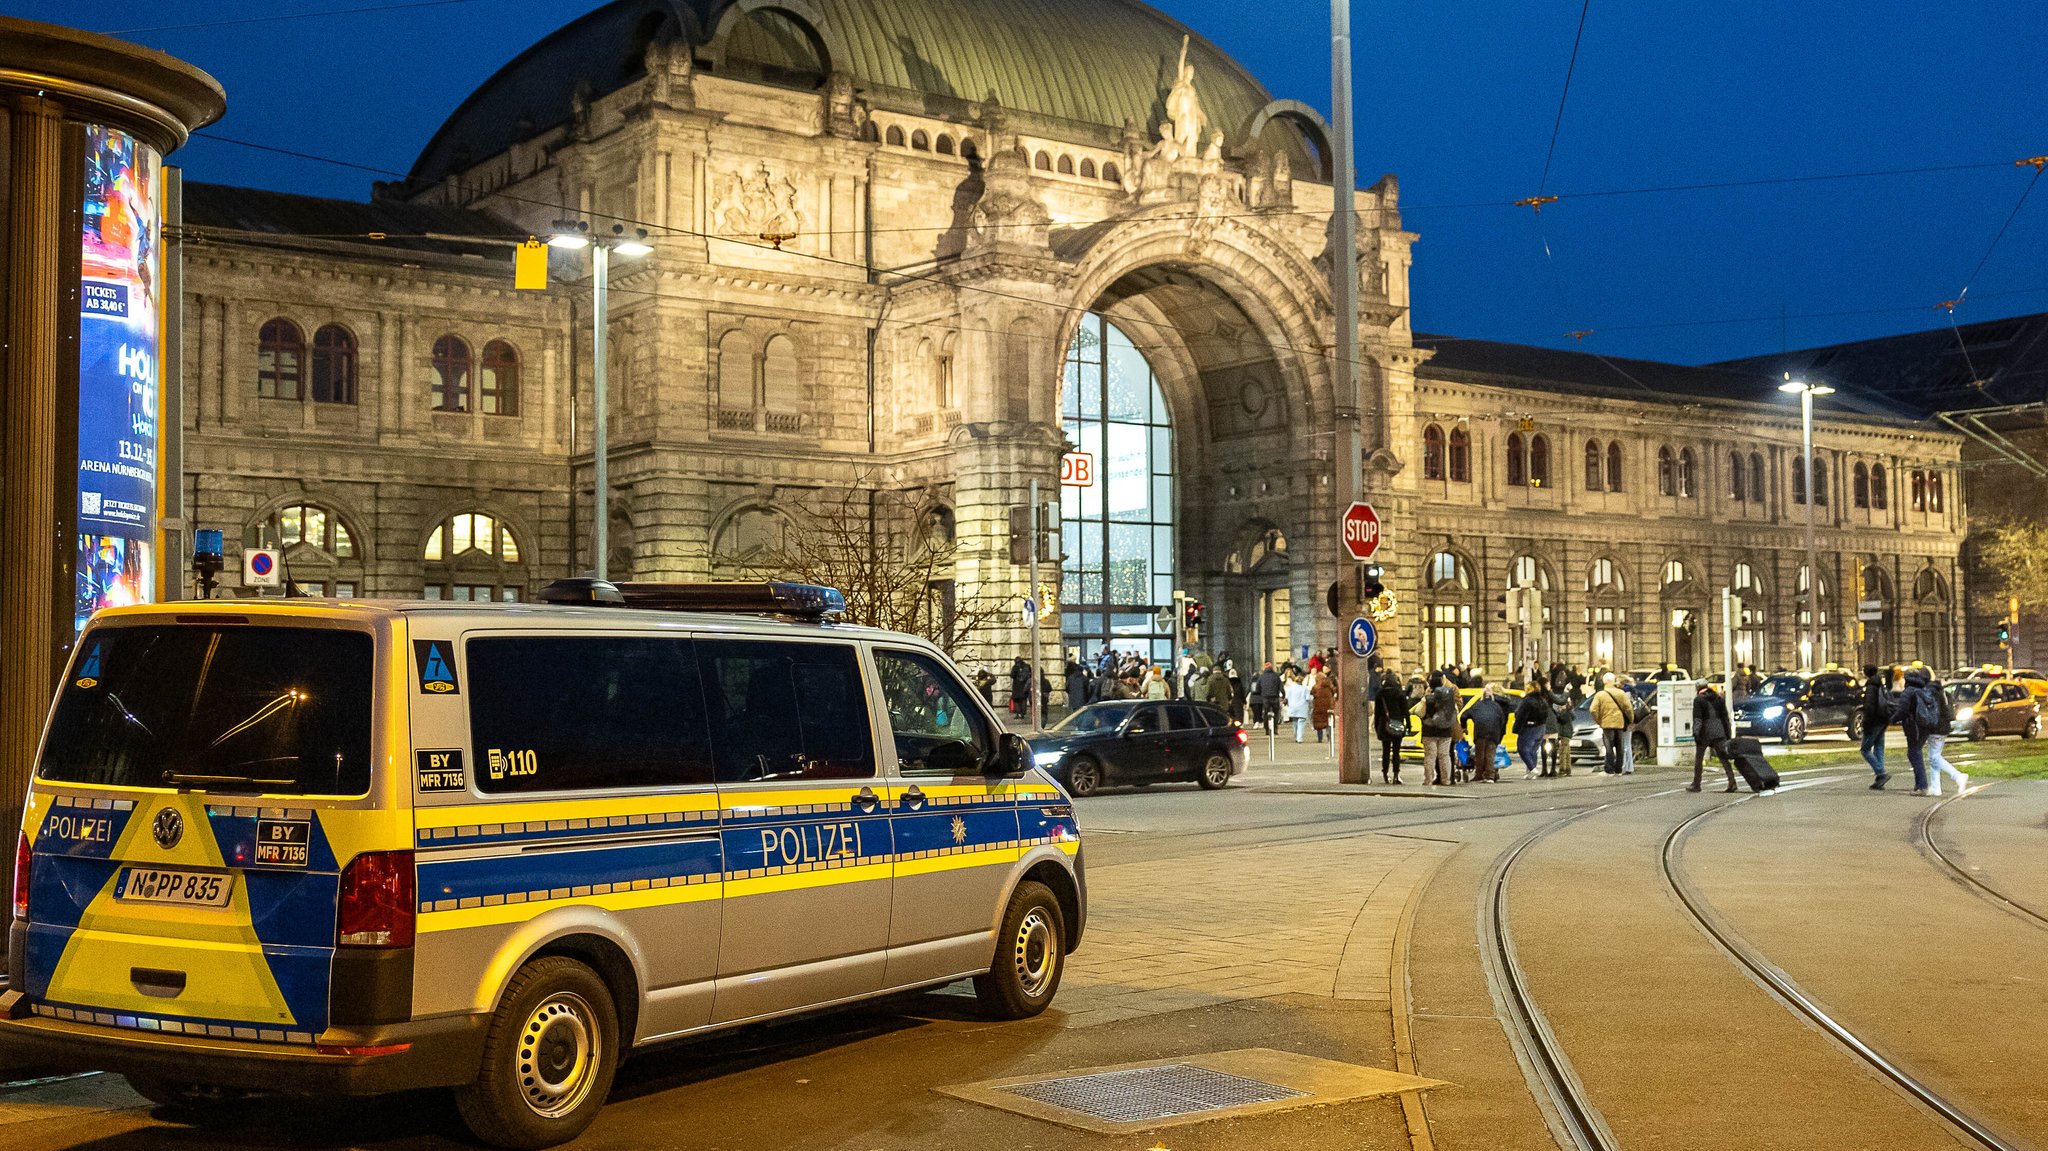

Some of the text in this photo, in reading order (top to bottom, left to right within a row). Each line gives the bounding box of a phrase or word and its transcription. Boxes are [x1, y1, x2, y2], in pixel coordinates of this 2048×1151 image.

[85, 285, 117, 299] TICKETS
[86, 298, 100, 309] AB
[80, 459, 111, 474] ARENA
[1060, 458, 1089, 481] DB
[1346, 518, 1378, 543] STOP
[430, 658, 441, 676] 7
[430, 753, 450, 767] BY
[508, 750, 538, 776] 110
[420, 773, 464, 788] MFR 7136
[48, 815, 112, 842] POLIZEI
[271, 825, 294, 840] BY
[257, 845, 306, 861] MFR 7136
[760, 822, 862, 867] POLIZEI
[183, 876, 223, 901] 835
